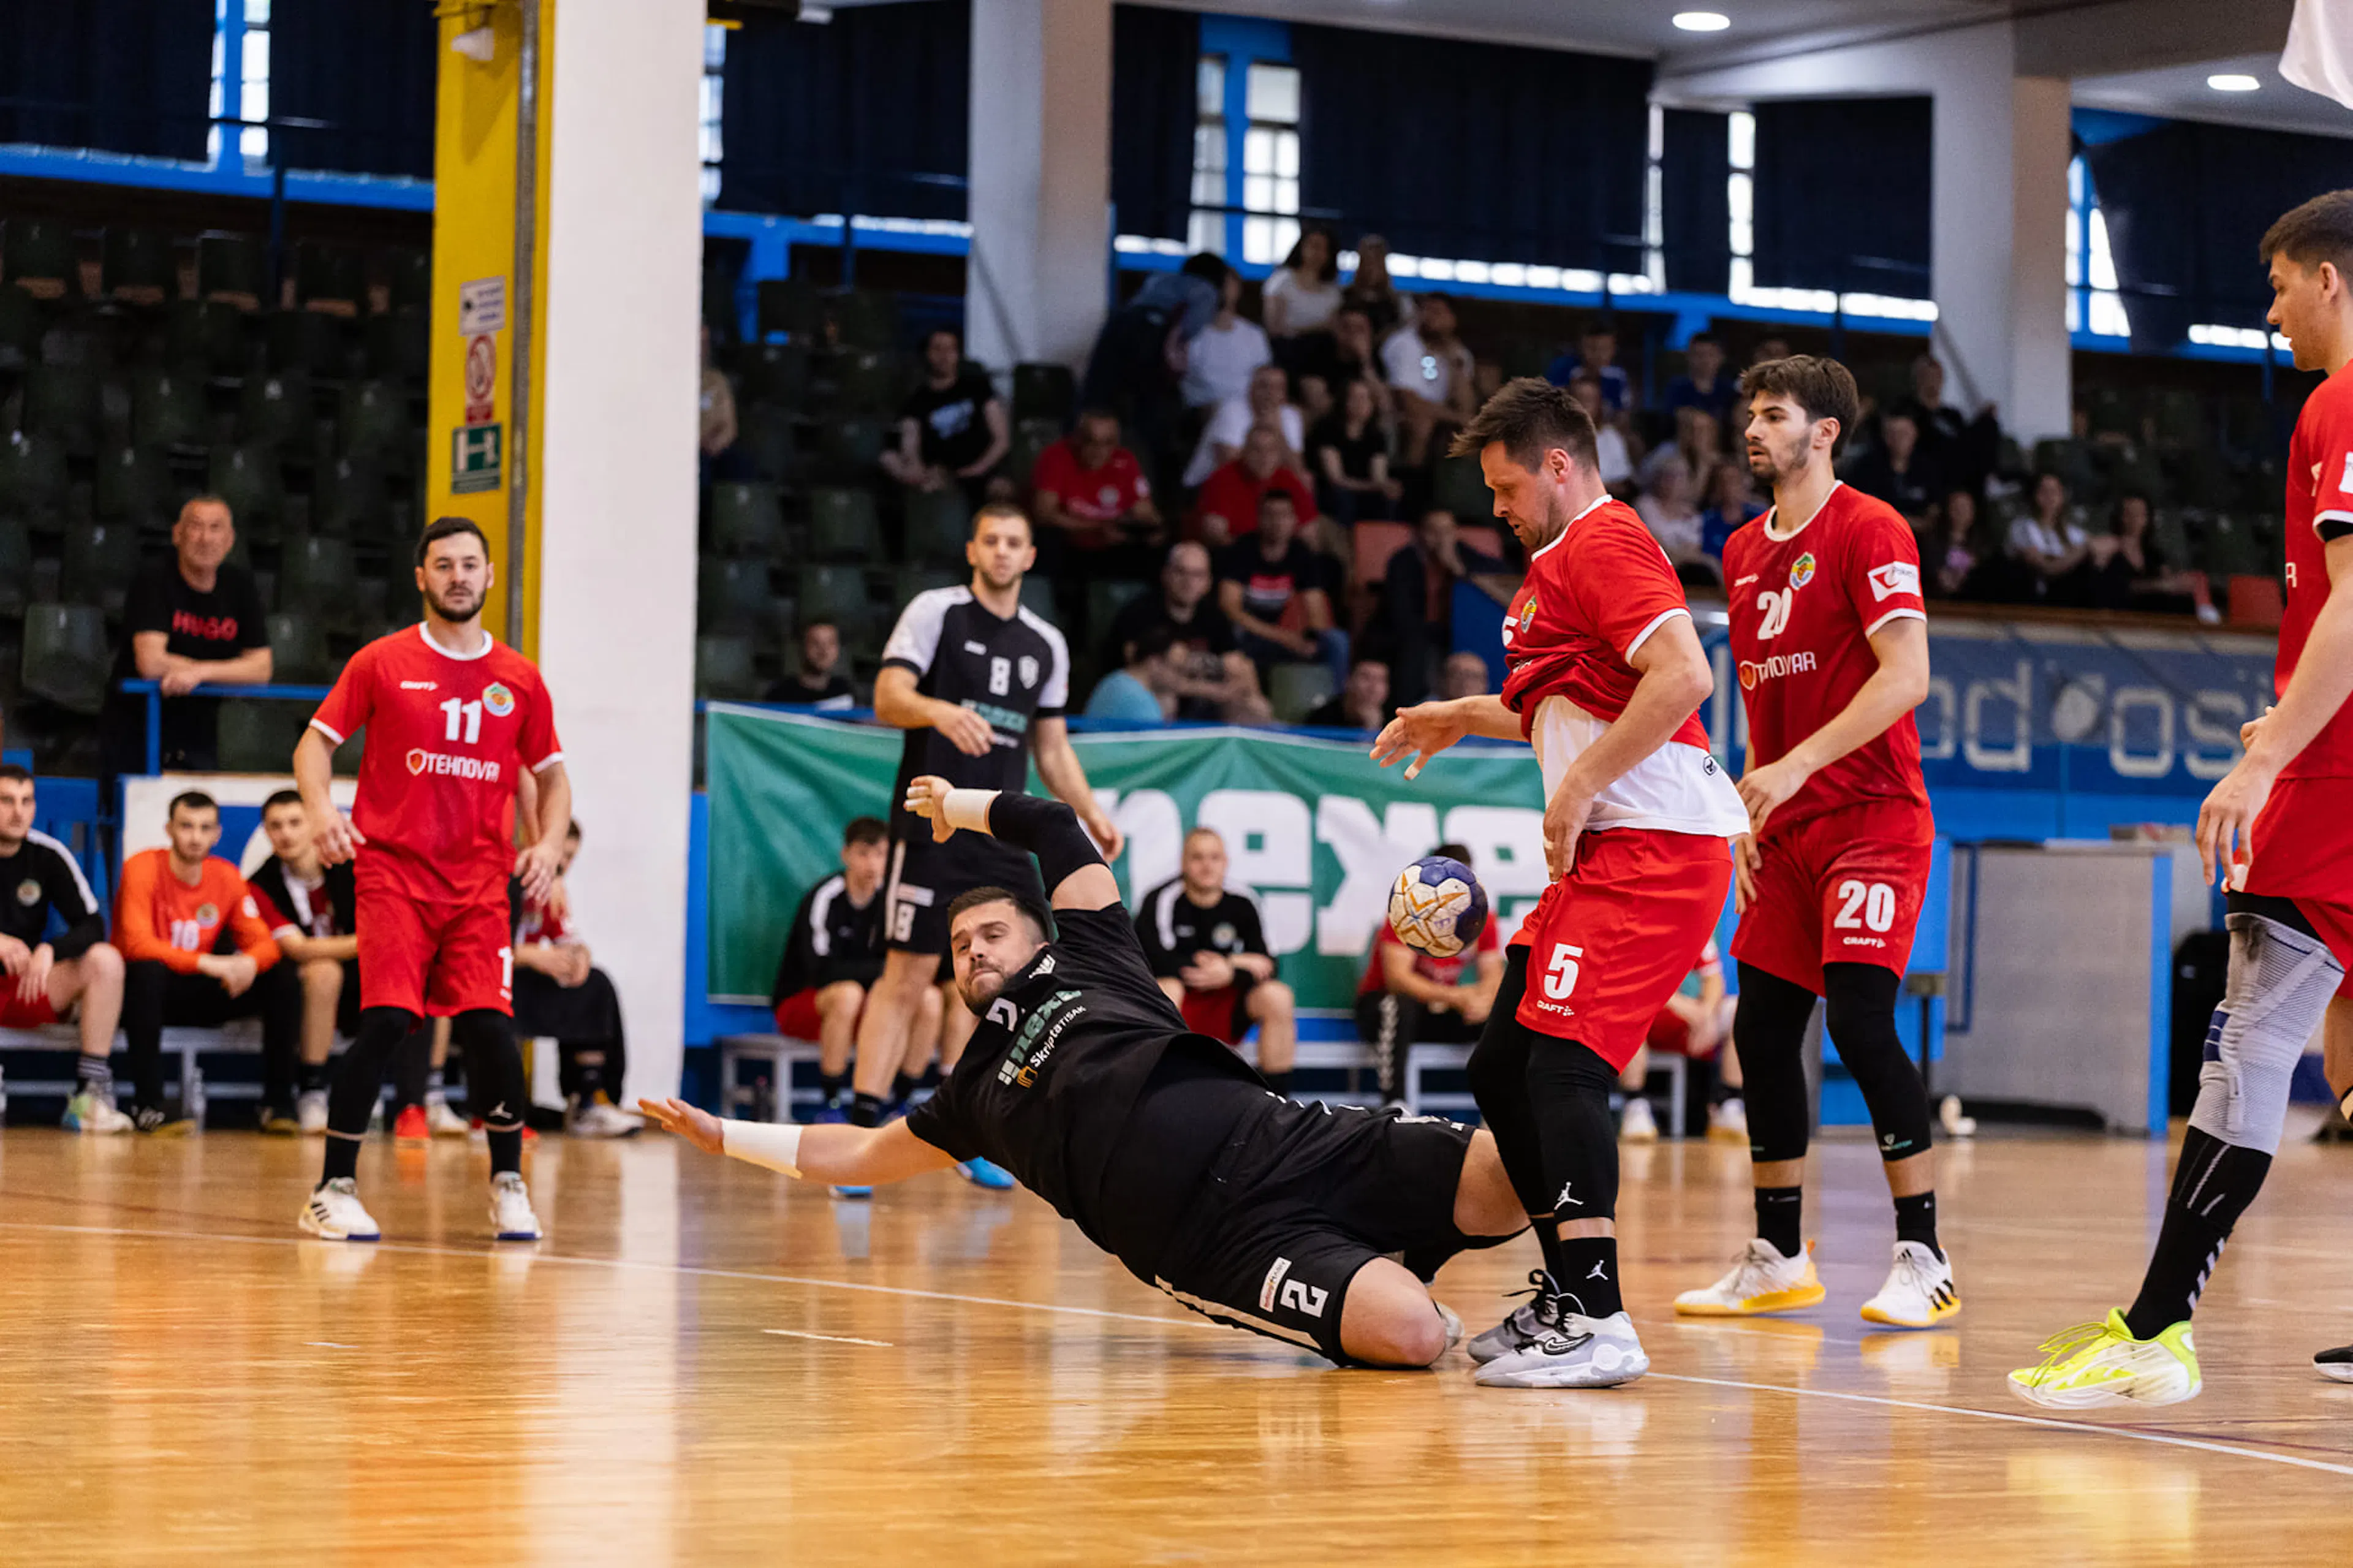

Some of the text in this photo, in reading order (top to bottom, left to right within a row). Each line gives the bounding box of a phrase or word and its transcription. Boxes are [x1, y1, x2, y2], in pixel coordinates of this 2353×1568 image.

[172, 608, 238, 641] HUGO
[988, 656, 1011, 697] 8
[439, 697, 482, 744] 11
[427, 752, 501, 784] TEHNOVA
[895, 903, 916, 942] 8
[1833, 880, 1895, 933] 20
[1544, 942, 1583, 1000] 5
[1279, 1278, 1329, 1318] 2
